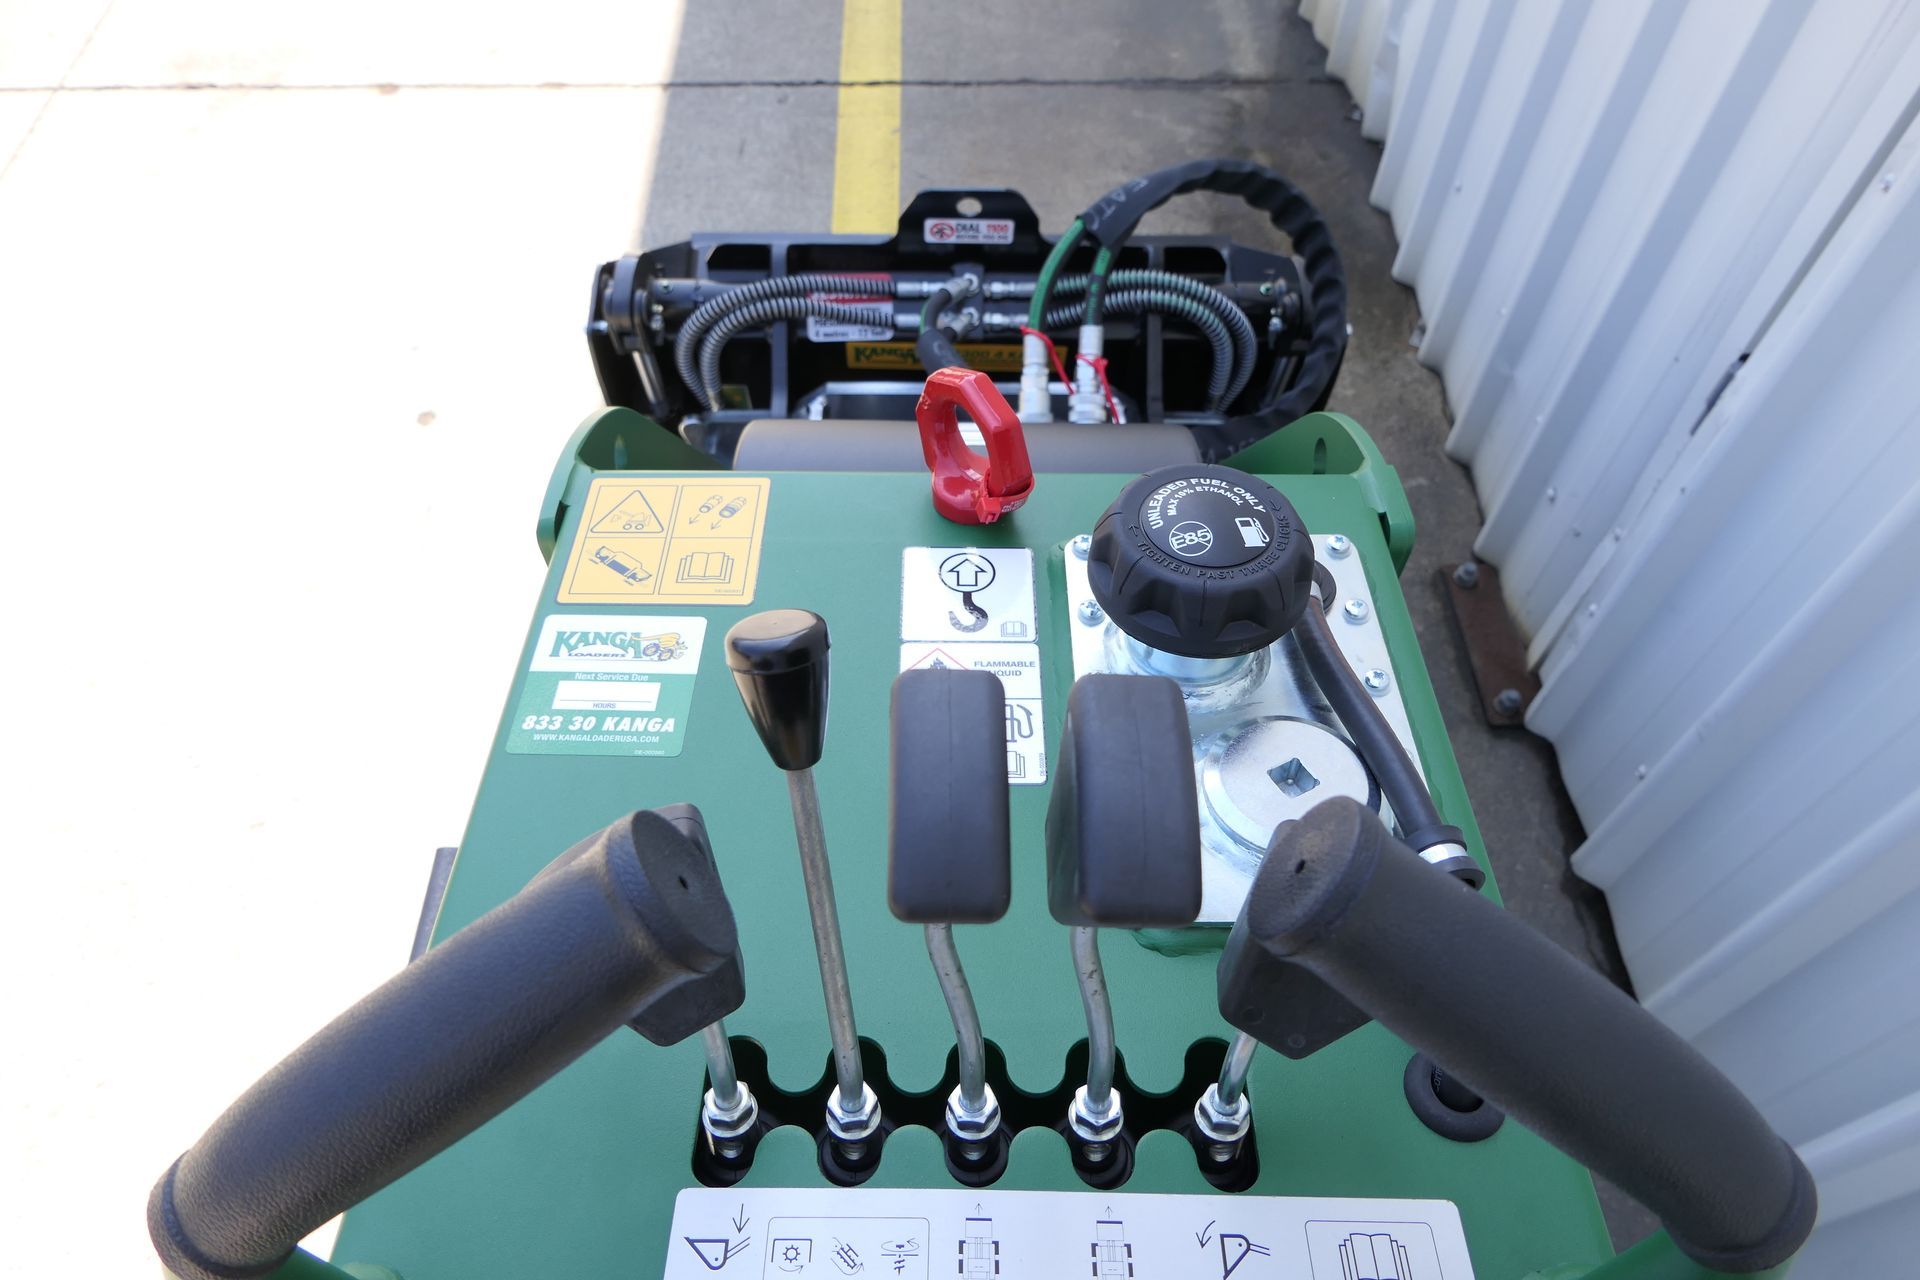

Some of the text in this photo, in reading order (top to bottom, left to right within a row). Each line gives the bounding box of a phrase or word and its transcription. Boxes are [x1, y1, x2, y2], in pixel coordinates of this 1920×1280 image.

[1148, 478, 1266, 530] UNLEADED FUEL ONLY
[1167, 486, 1245, 516] MAX 10% ETHANOL
[1137, 514, 1290, 581] TIGHTEN PAST THREE CLICKS
[1171, 528, 1212, 550] E85
[549, 630, 642, 659] KANGA
[974, 660, 1036, 668] FLAMMABLE
[574, 672, 649, 682] Next Service Due
[522, 715, 676, 733] 833 30 KANGA
[532, 733, 660, 744] WWW.KANGALOADERUSA.COM
